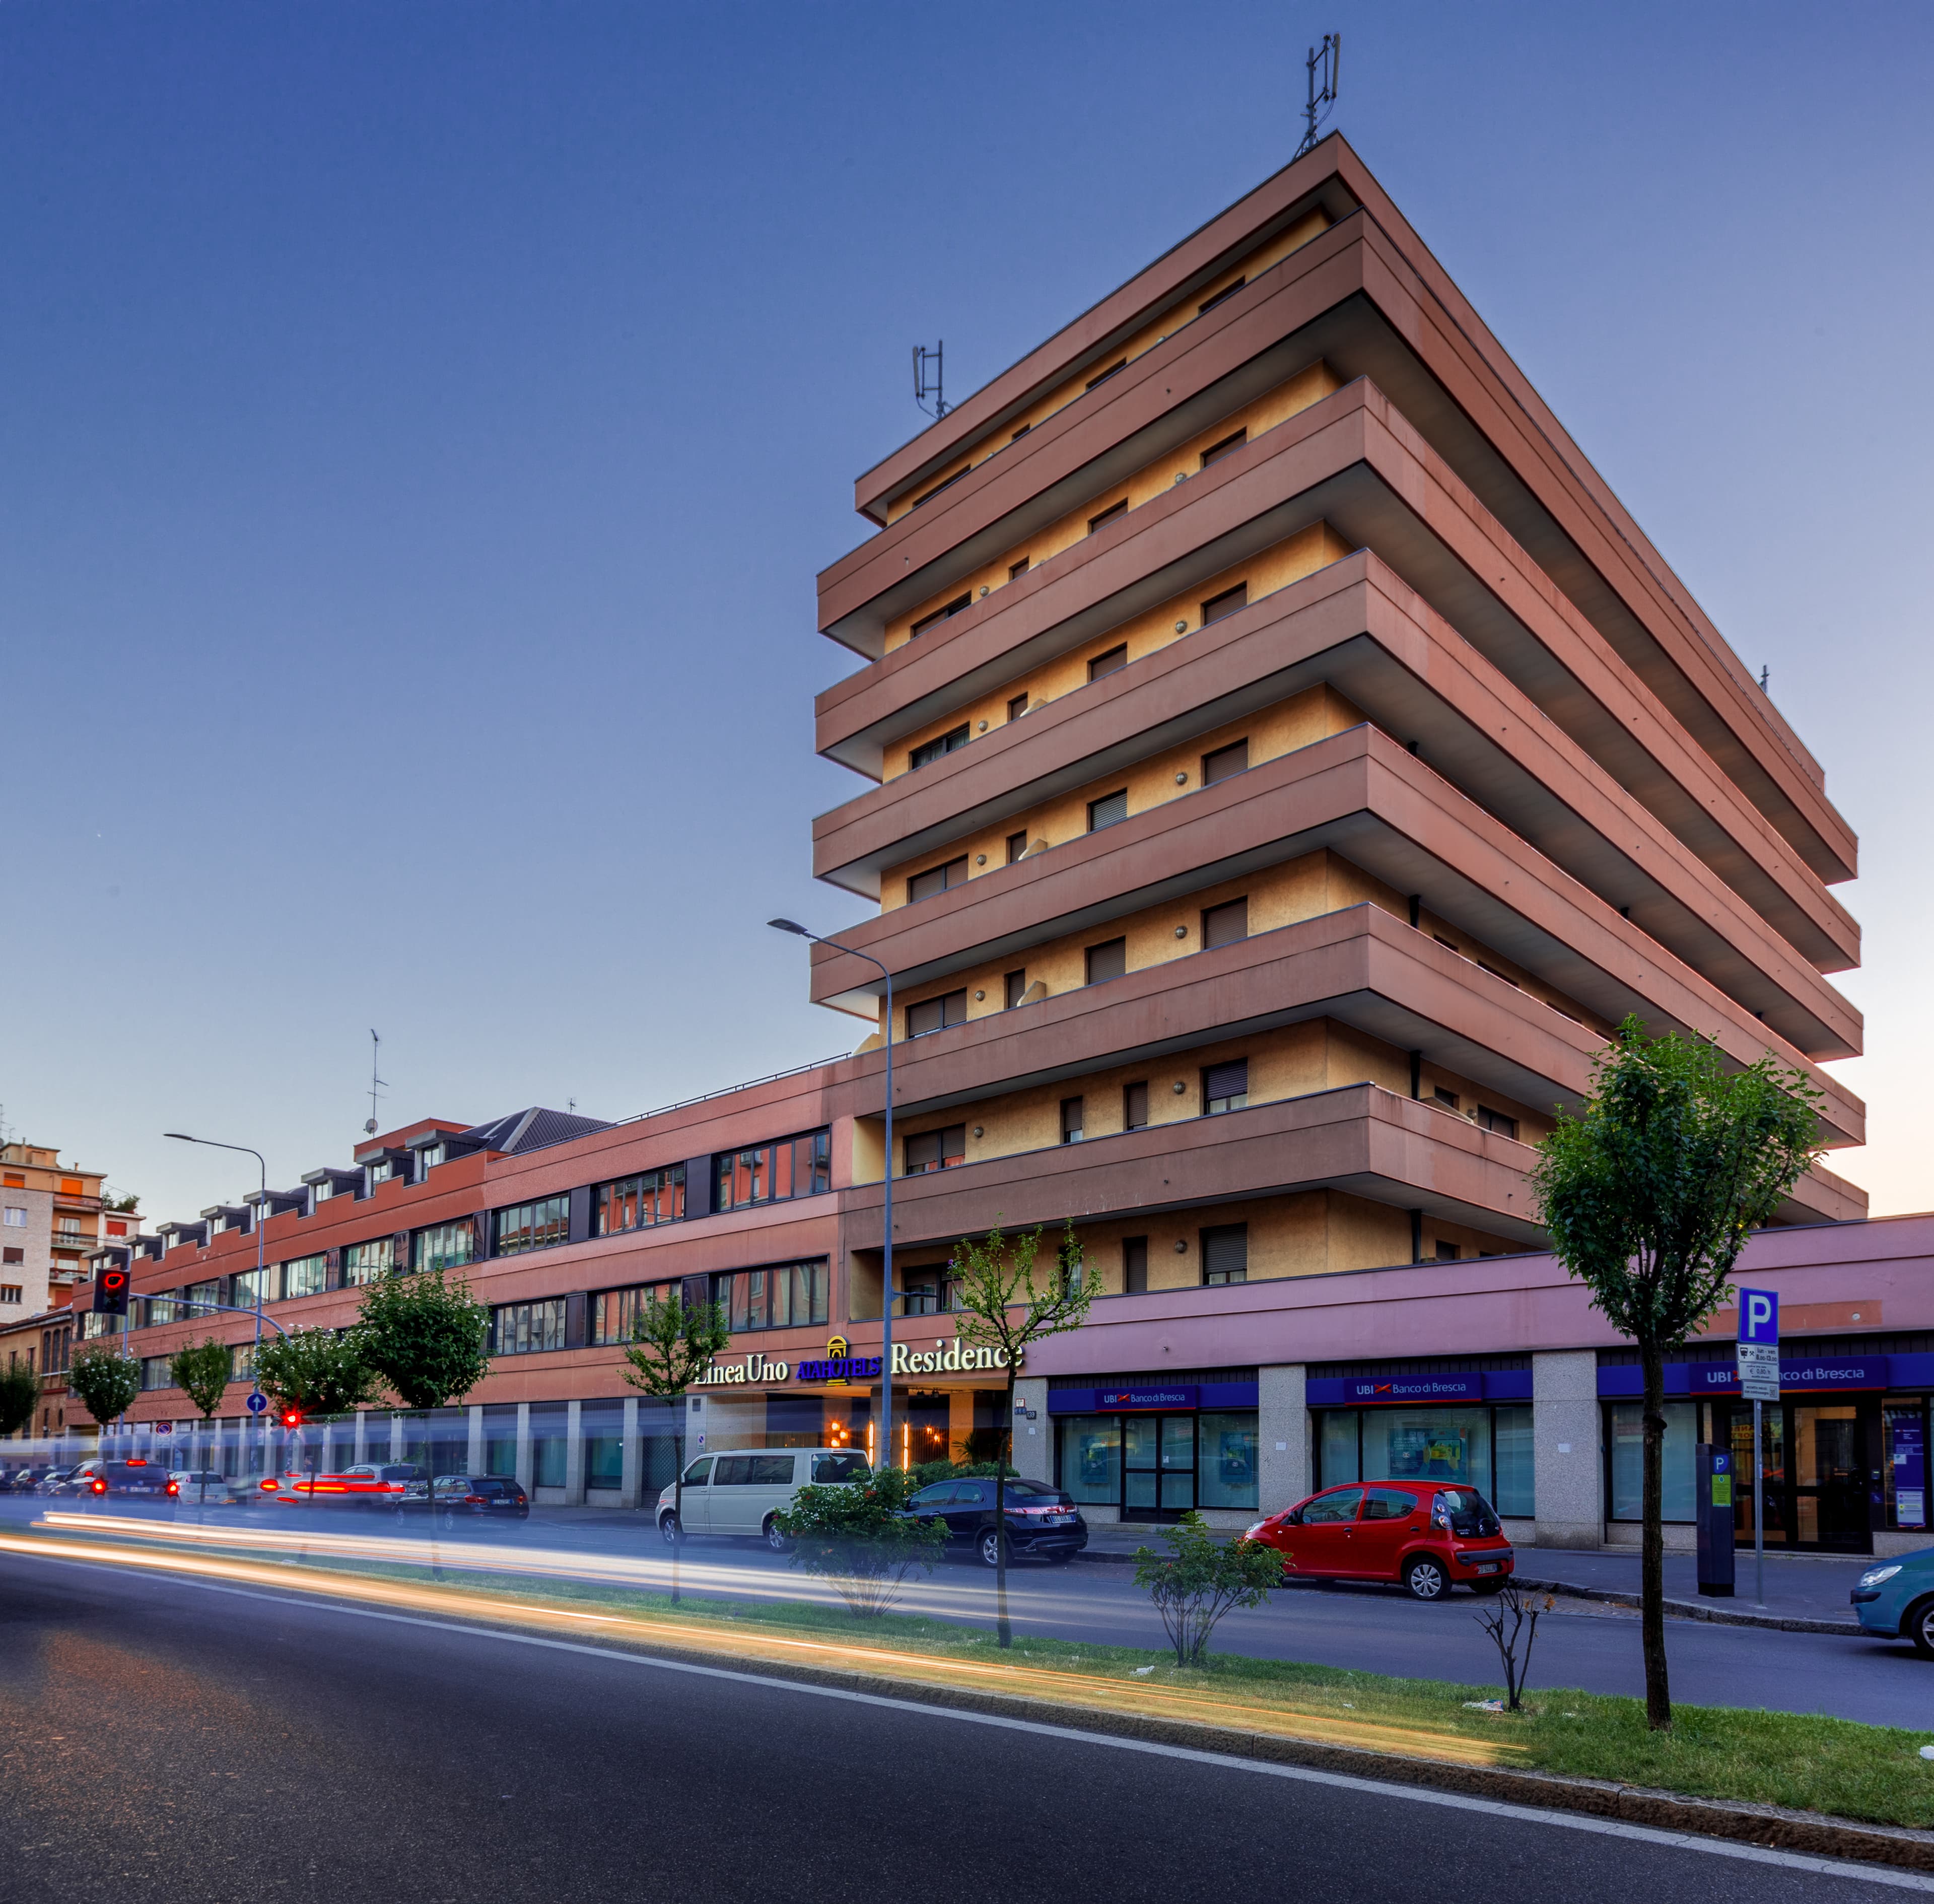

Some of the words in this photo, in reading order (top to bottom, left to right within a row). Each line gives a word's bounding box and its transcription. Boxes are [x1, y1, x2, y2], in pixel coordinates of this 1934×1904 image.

[1749, 1295, 1771, 1338] P
[795, 1356, 882, 1380] ATAHOTELS
[1707, 1372, 1731, 1383] UBI
[1802, 1369, 1813, 1380] di
[1816, 1368, 1865, 1379] Brescia
[1357, 1385, 1373, 1394] UBI
[1393, 1384, 1421, 1393] Banco
[1422, 1383, 1431, 1392] di
[1432, 1383, 1466, 1392] Brescia
[1104, 1395, 1117, 1403] UBI
[1131, 1394, 1152, 1402] Banco
[1160, 1393, 1185, 1401] Brescia
[1716, 1457, 1724, 1470] P
